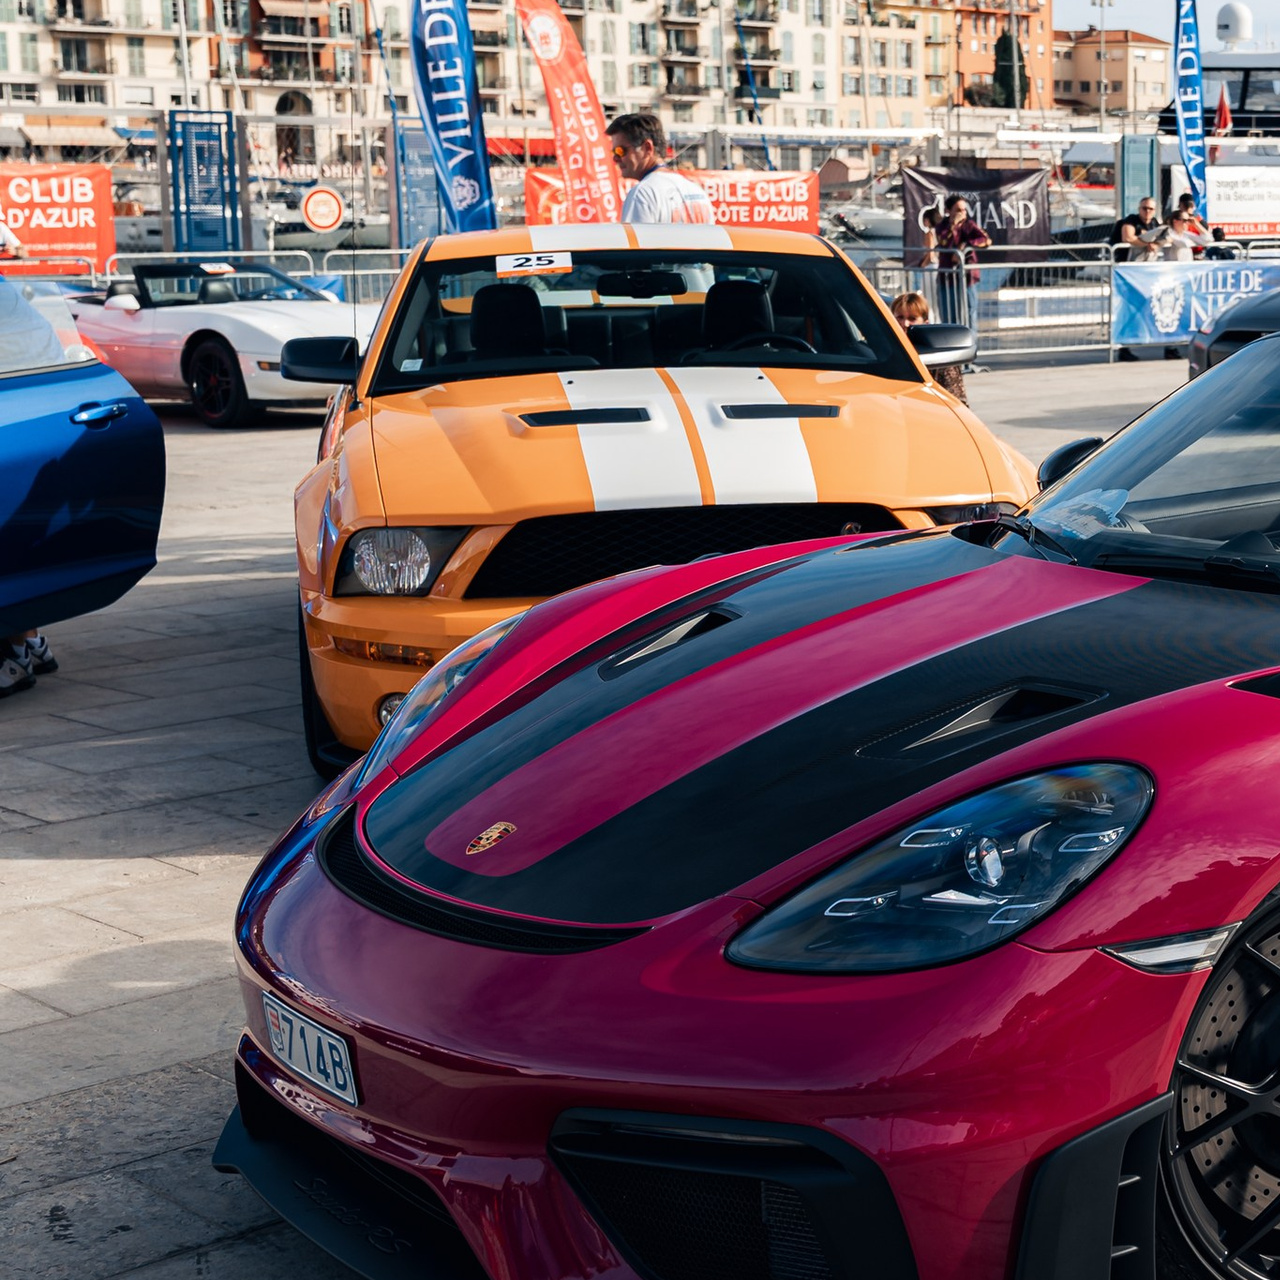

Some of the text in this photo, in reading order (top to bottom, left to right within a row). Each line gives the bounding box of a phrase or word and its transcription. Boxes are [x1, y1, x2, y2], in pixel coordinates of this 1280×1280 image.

[1177, 32, 1199, 78] DE
[427, 57, 475, 170] VILLE
[1180, 86, 1205, 172] VILLE
[8, 177, 95, 203] CLUB
[755, 182, 809, 202] CLUB
[7, 207, 97, 228] D'AZUR
[754, 206, 809, 222] D'AZUR
[513, 255, 555, 268] 25
[1187, 269, 1263, 293] VILLE DE
